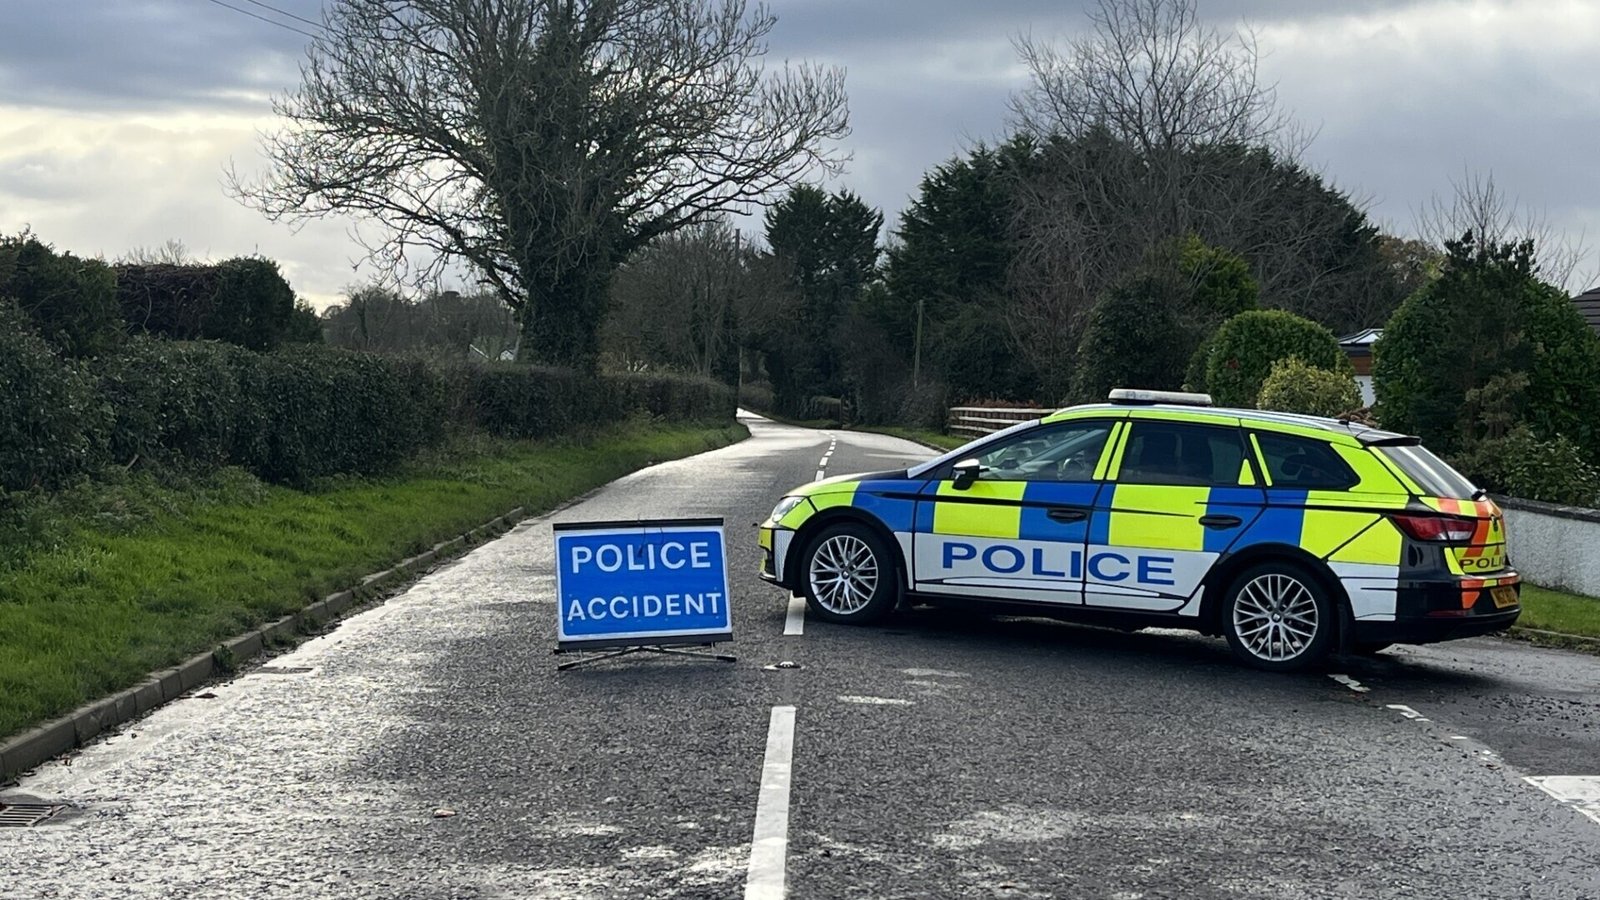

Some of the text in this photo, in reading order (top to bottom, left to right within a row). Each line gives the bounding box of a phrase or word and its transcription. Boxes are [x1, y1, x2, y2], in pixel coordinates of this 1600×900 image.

[572, 542, 711, 573] POLICE
[943, 542, 1175, 585] POLICE
[567, 593, 721, 621] ACCIDENT
